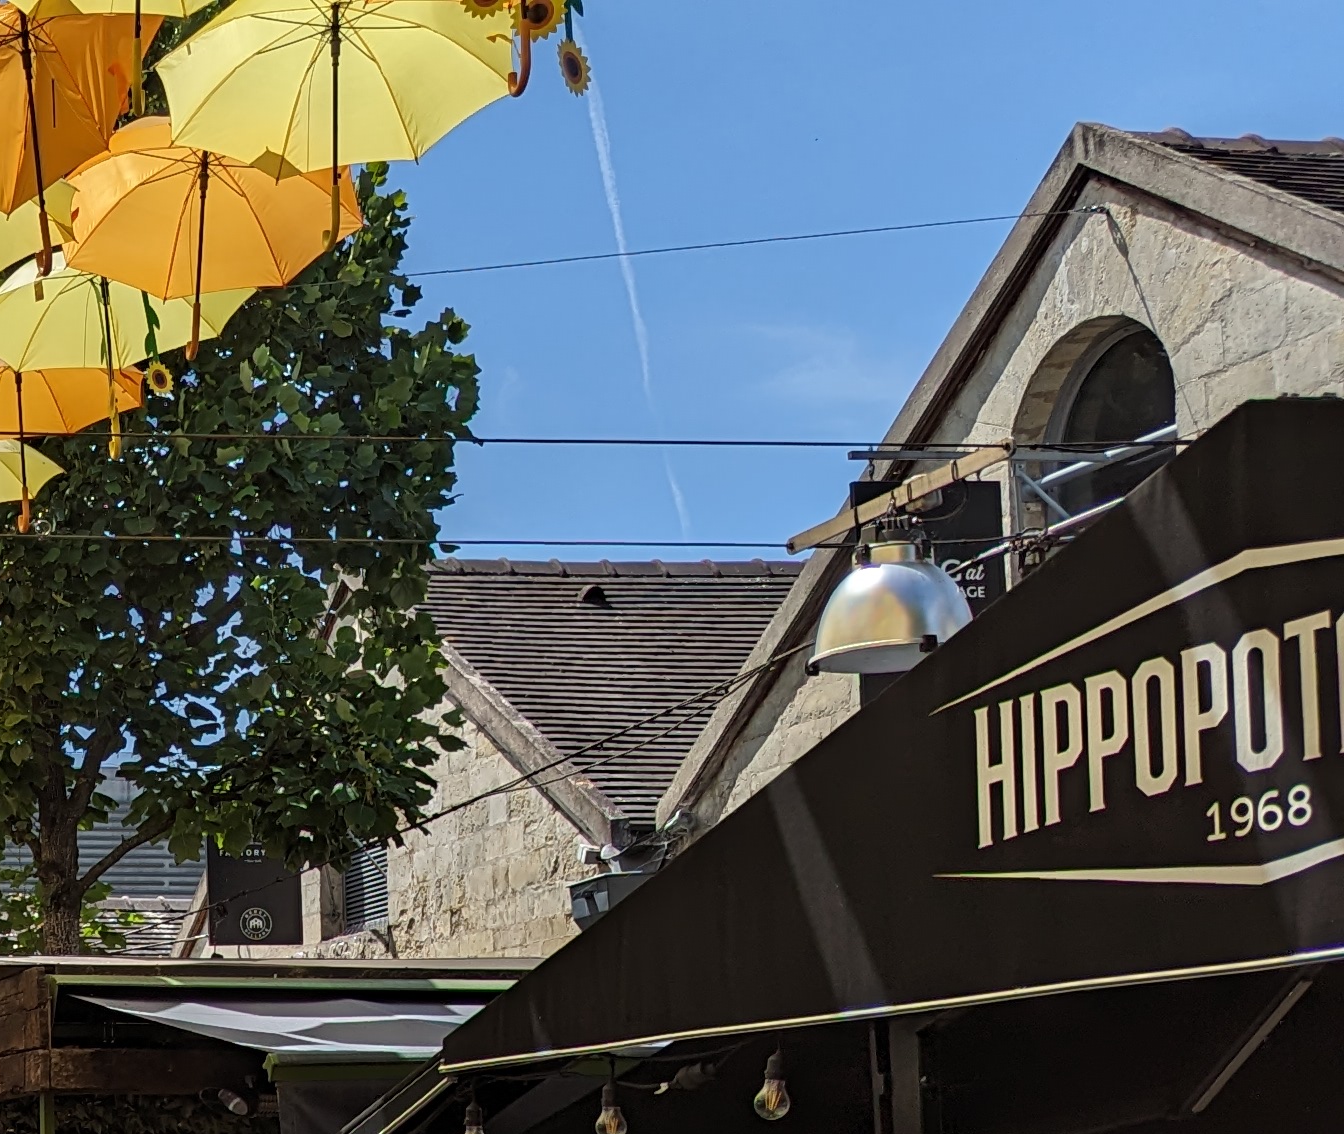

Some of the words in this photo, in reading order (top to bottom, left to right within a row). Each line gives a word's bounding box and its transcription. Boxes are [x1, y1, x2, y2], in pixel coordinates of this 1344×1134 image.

[965, 564, 985, 580] at
[974, 609, 1344, 849] HIPPOPOT
[1206, 784, 1312, 841] 1968
